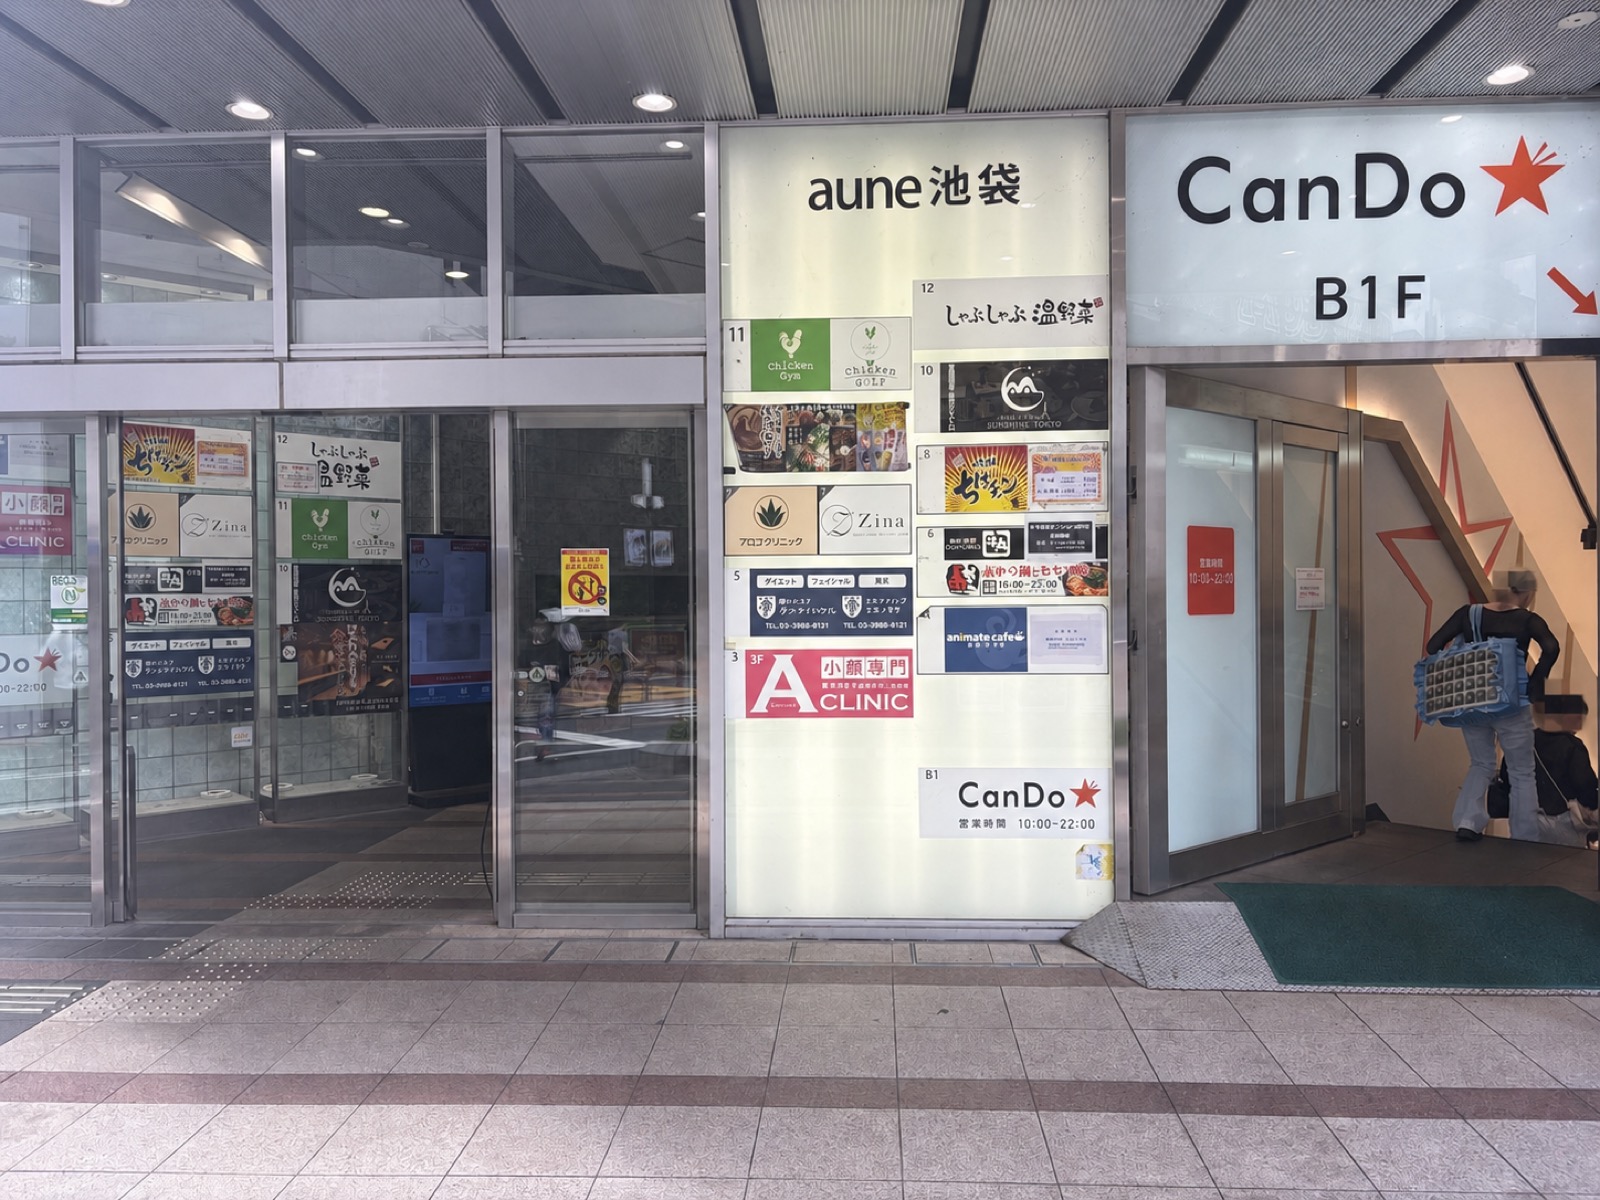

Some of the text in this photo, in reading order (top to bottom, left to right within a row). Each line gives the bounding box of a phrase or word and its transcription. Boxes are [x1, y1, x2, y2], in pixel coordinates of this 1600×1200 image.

[1177, 152, 1466, 225] CanDo
[921, 283, 935, 294] 12
[1316, 275, 1425, 321] B1F
[728, 327, 744, 342] 11
[921, 365, 934, 376] 10
[779, 372, 801, 382] Gym
[277, 435, 288, 445] 12
[923, 449, 931, 459] 8
[278, 501, 288, 511] 11
[211, 520, 248, 532] Zina
[857, 512, 905, 529] Zina
[927, 529, 935, 538] 6
[6, 535, 65, 548] CLINIC
[279, 565, 289, 573] 10
[733, 570, 740, 581] 5
[764, 577, 797, 587] ダイエット
[946, 631, 1015, 643] animate cafe
[731, 652, 738, 662] 3
[750, 654, 764, 665] 3F
[822, 658, 908, 677] 小顔専門
[750, 654, 909, 713] A CLINIC
[925, 769, 939, 780] B1
[958, 781, 1066, 808] CanDo
